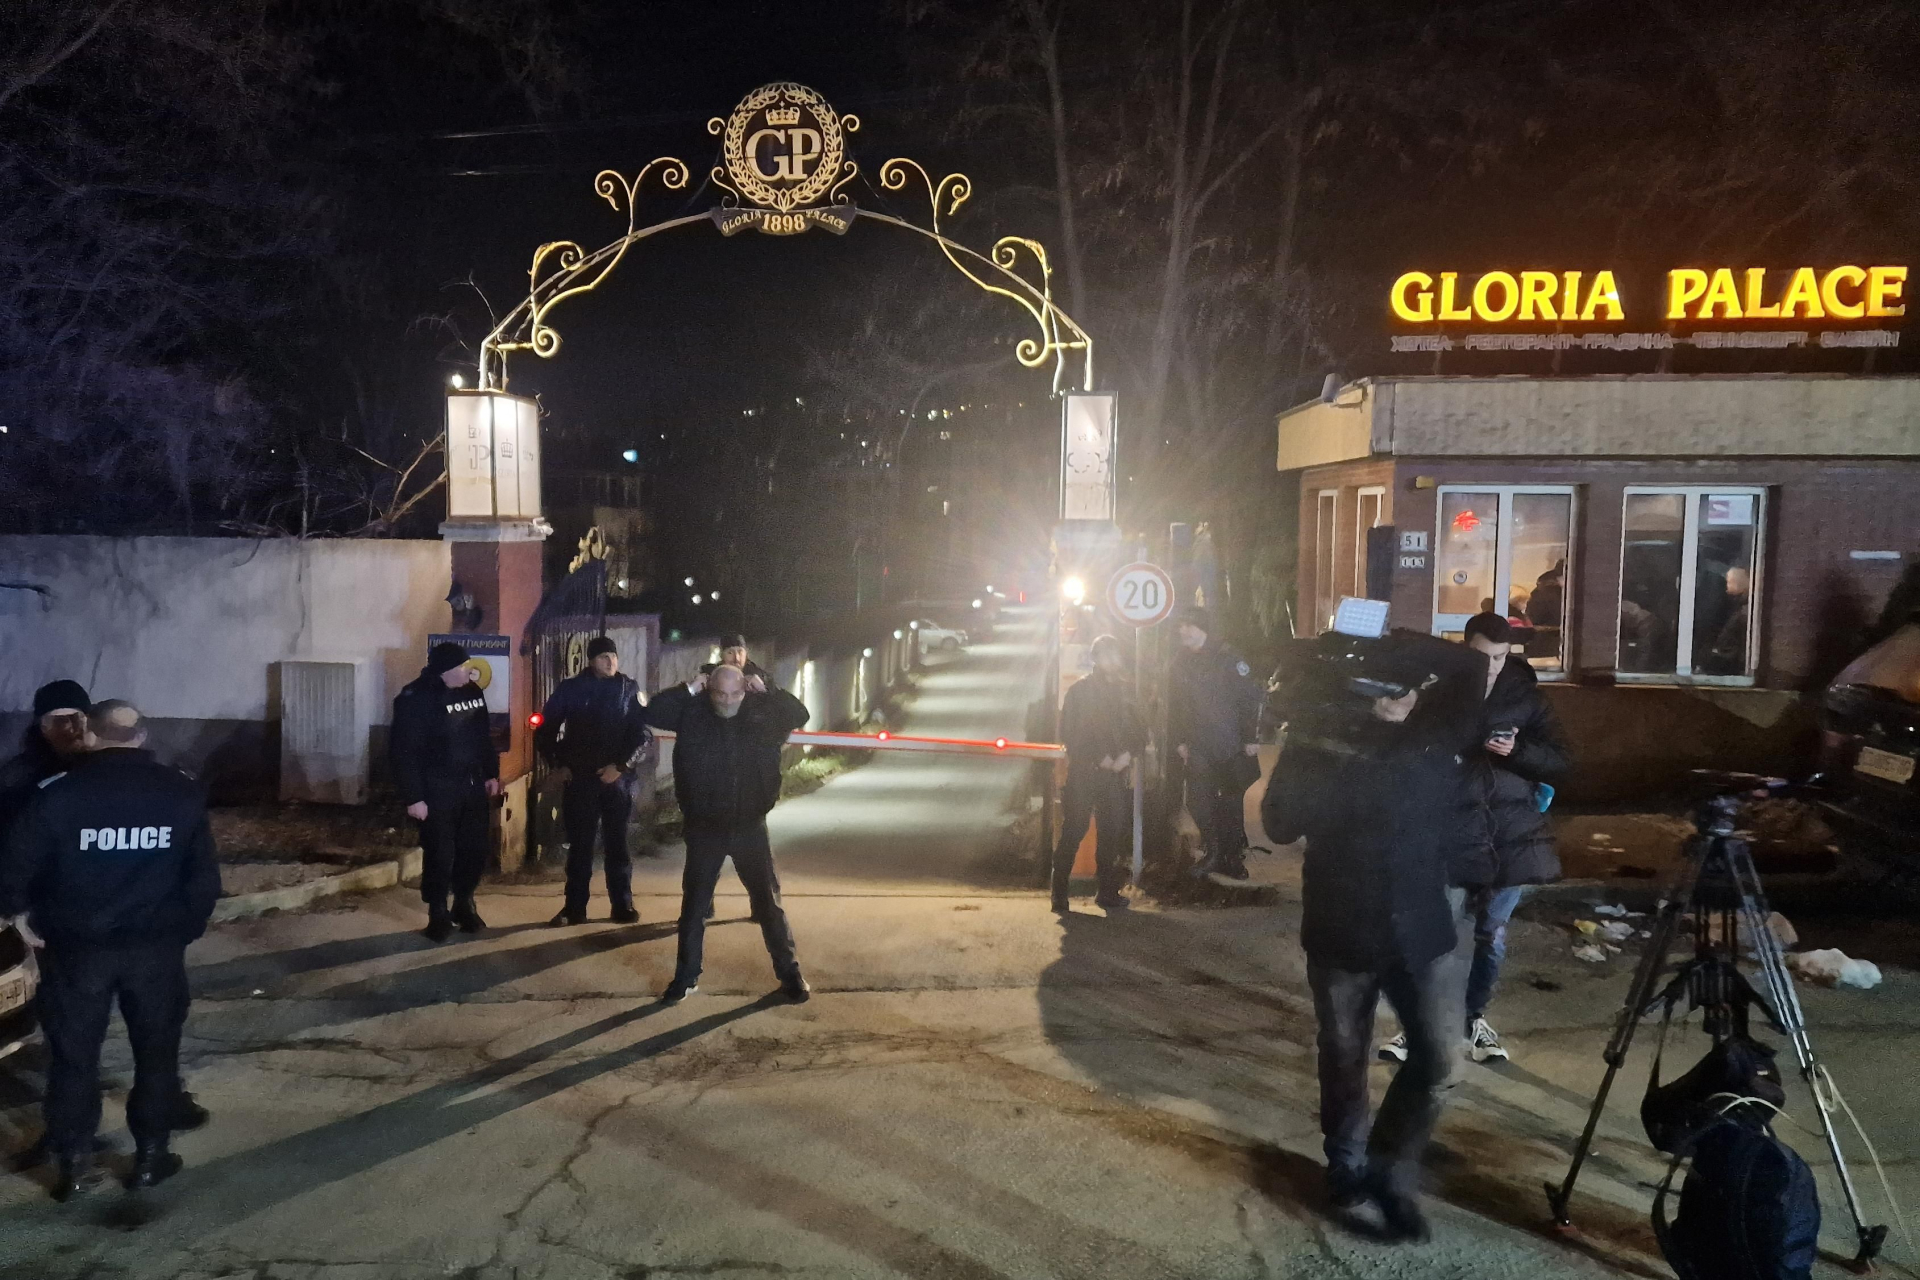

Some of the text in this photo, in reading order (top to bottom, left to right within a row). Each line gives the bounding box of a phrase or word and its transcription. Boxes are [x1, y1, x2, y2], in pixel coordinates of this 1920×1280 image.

[745, 128, 822, 182] GP
[721, 210, 847, 234] GLORIA 1898 PALACE
[1390, 265, 1908, 322] GLORIA PALACE
[1404, 535, 1421, 548] 51
[1122, 579, 1159, 610] 20
[446, 698, 485, 714] POLICE
[79, 826, 173, 851] POLICE
